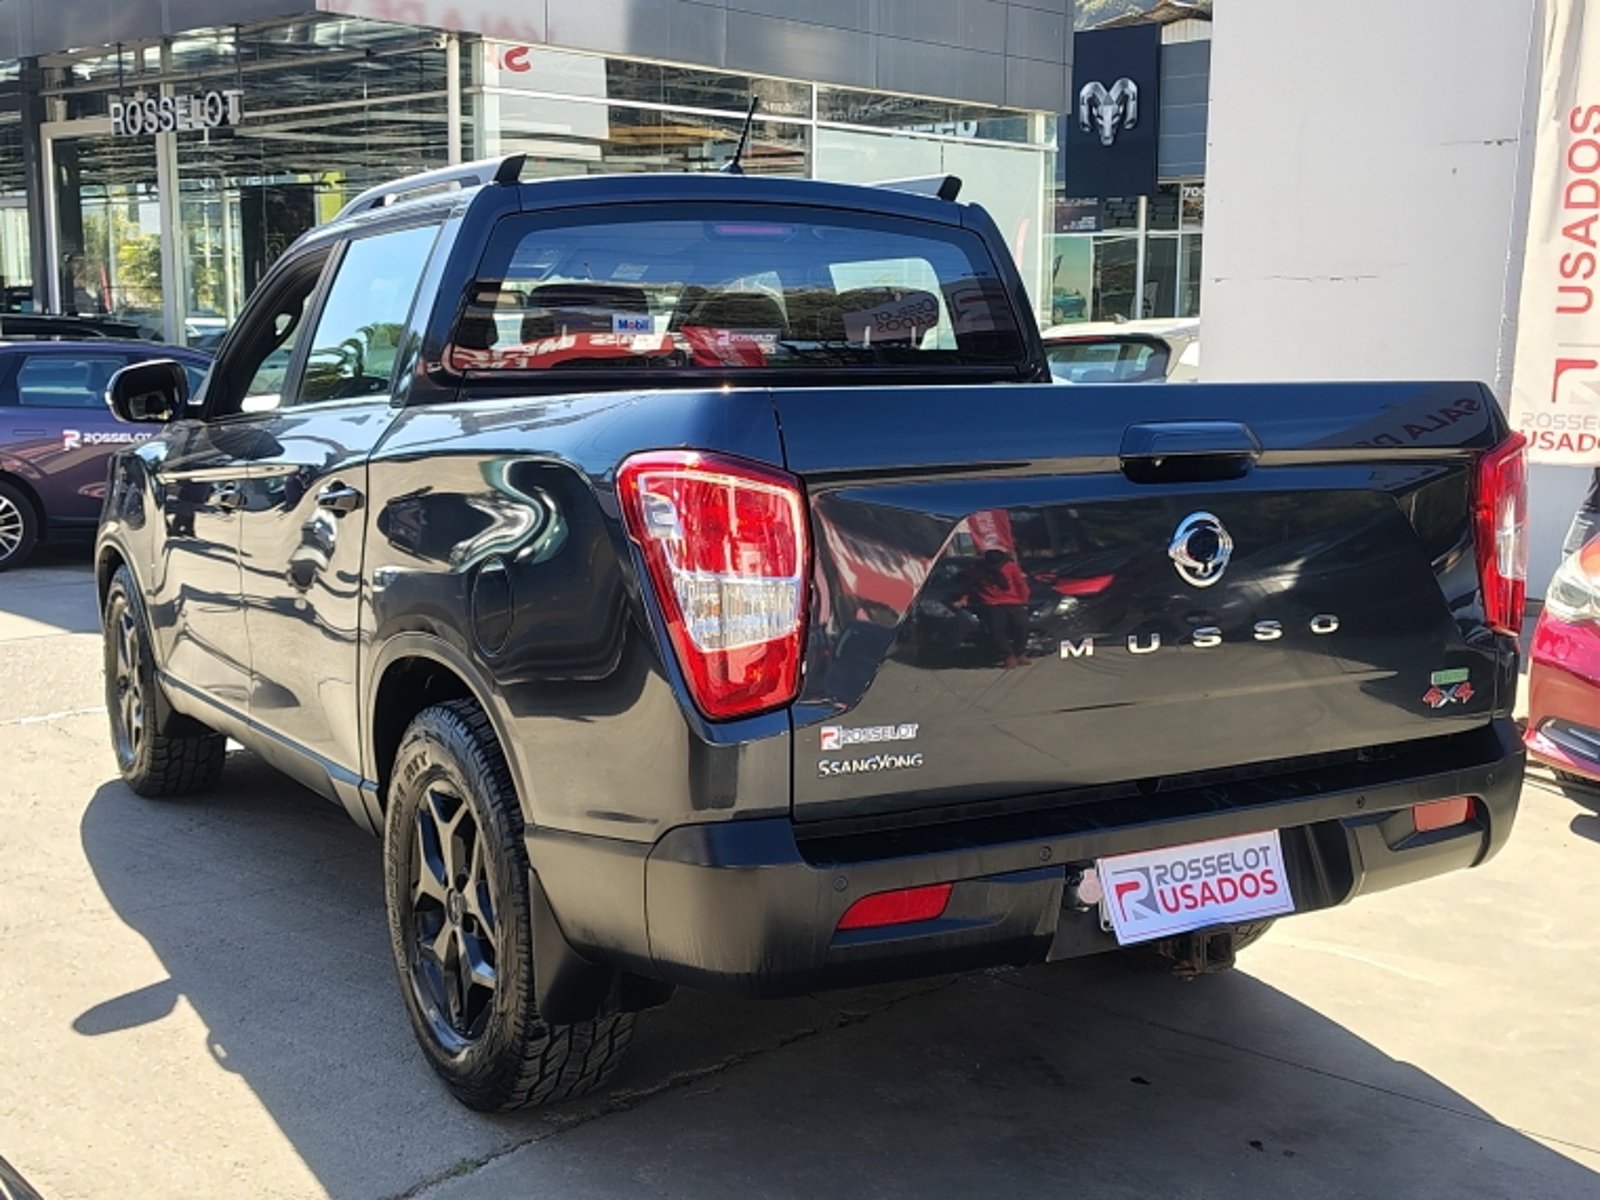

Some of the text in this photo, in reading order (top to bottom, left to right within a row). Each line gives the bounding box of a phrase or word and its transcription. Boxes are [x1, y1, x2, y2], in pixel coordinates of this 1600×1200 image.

[109, 90, 245, 136] ROSSELOT
[1556, 104, 1600, 314] USADOS
[618, 319, 649, 331] Mobil
[1521, 412, 1600, 430] ROSSE
[83, 432, 152, 445] ROSSELOT
[1520, 430, 1600, 452] USAD
[1060, 613, 1339, 658] MUSSO
[842, 724, 918, 744] ROSSELOT
[1154, 846, 1270, 886] ROSSELOT
[1158, 869, 1278, 914] USADOS
